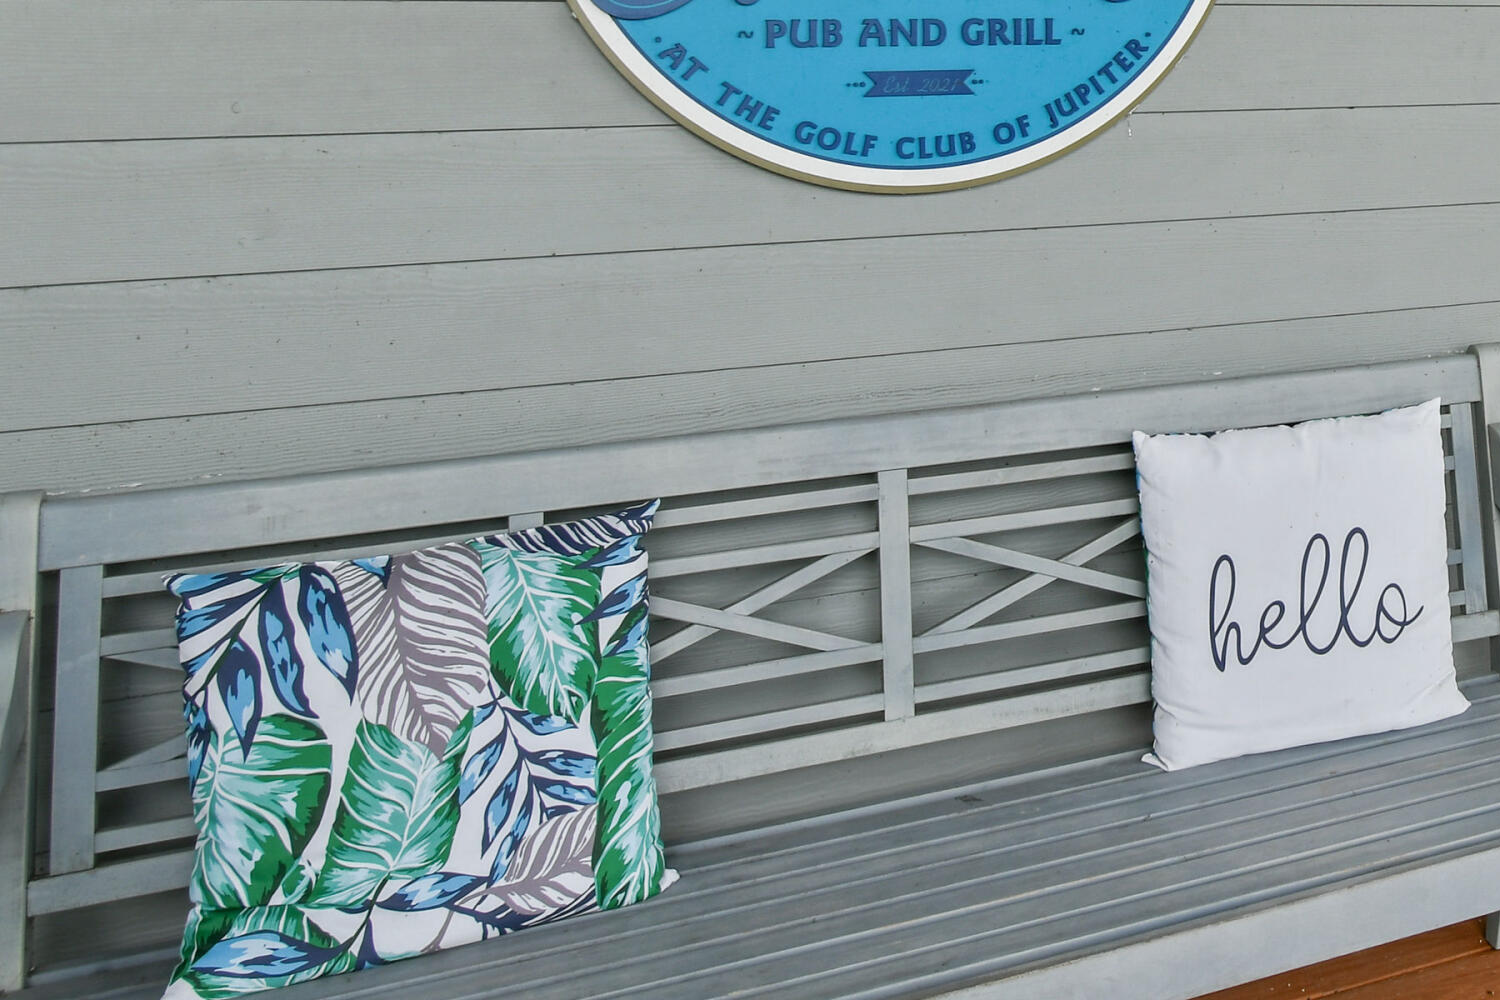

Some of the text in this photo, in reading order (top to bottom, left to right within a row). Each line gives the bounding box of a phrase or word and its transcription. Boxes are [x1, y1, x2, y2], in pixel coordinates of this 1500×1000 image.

[764, 17, 1062, 48] PUB AND GRILL
[657, 37, 1150, 160] AT THE GOLF CLUB OF JUPITER
[1209, 526, 1424, 673] hello
